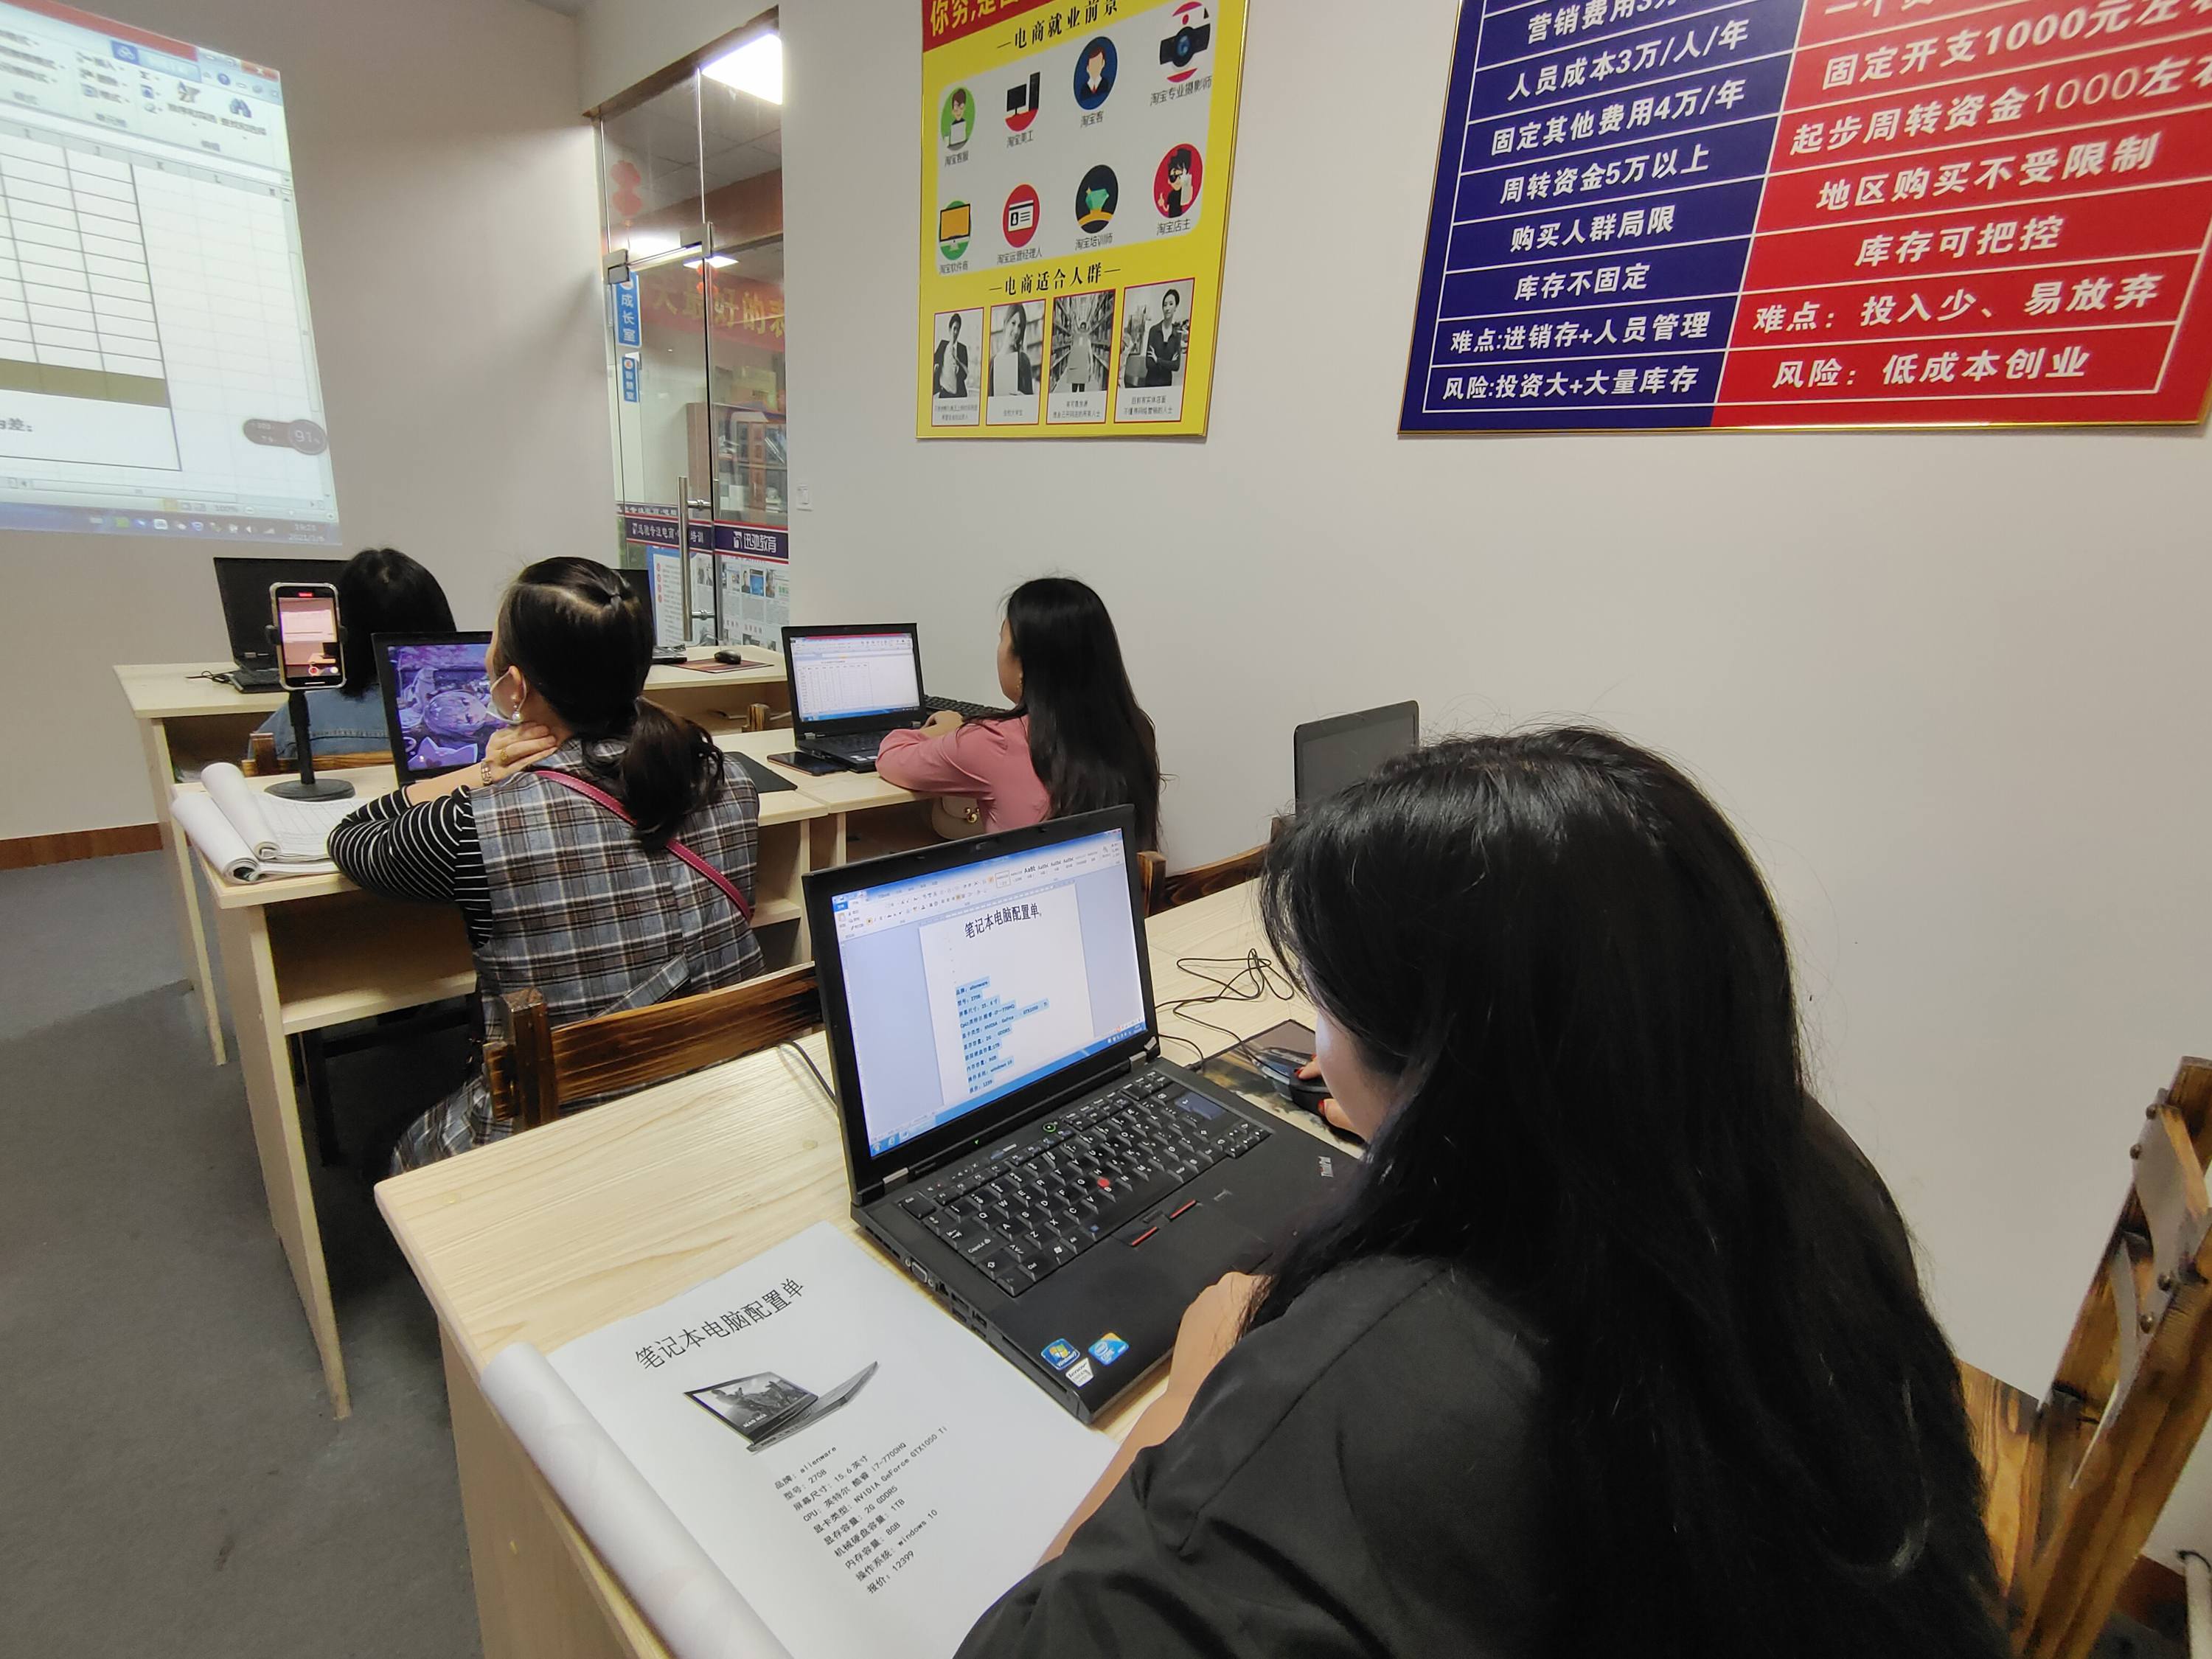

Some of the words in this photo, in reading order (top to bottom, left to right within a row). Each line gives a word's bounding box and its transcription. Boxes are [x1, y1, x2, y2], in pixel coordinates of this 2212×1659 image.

[1507, 18, 1750, 101] 人员成本3万/人/年
[1822, 0, 2212, 90] 固定开支1000元左
[1490, 79, 1747, 156] 固定其他费用4万/年
[1500, 143, 1711, 204] 周转资金5万以上
[1816, 132, 2162, 210] 地区购买不受限制
[1156, 218, 1191, 235] 淘宝店主
[1509, 204, 1676, 252] 购买人群局限
[1855, 215, 2065, 267] 库存可把控
[1005, 262, 1102, 296] 电商适合人群
[1514, 262, 1651, 302] 库存不固定
[1450, 310, 1711, 354] 难点:进销存+人员管理
[1442, 366, 1700, 402] 风险:投资大+大量库存
[964, 902, 1040, 939] 笔记本电脑配置单
[635, 1277, 804, 1370] 笔记本电脑配置单
[880, 1458, 910, 1482] GeForce
[910, 1433, 938, 1458] GTX1050
